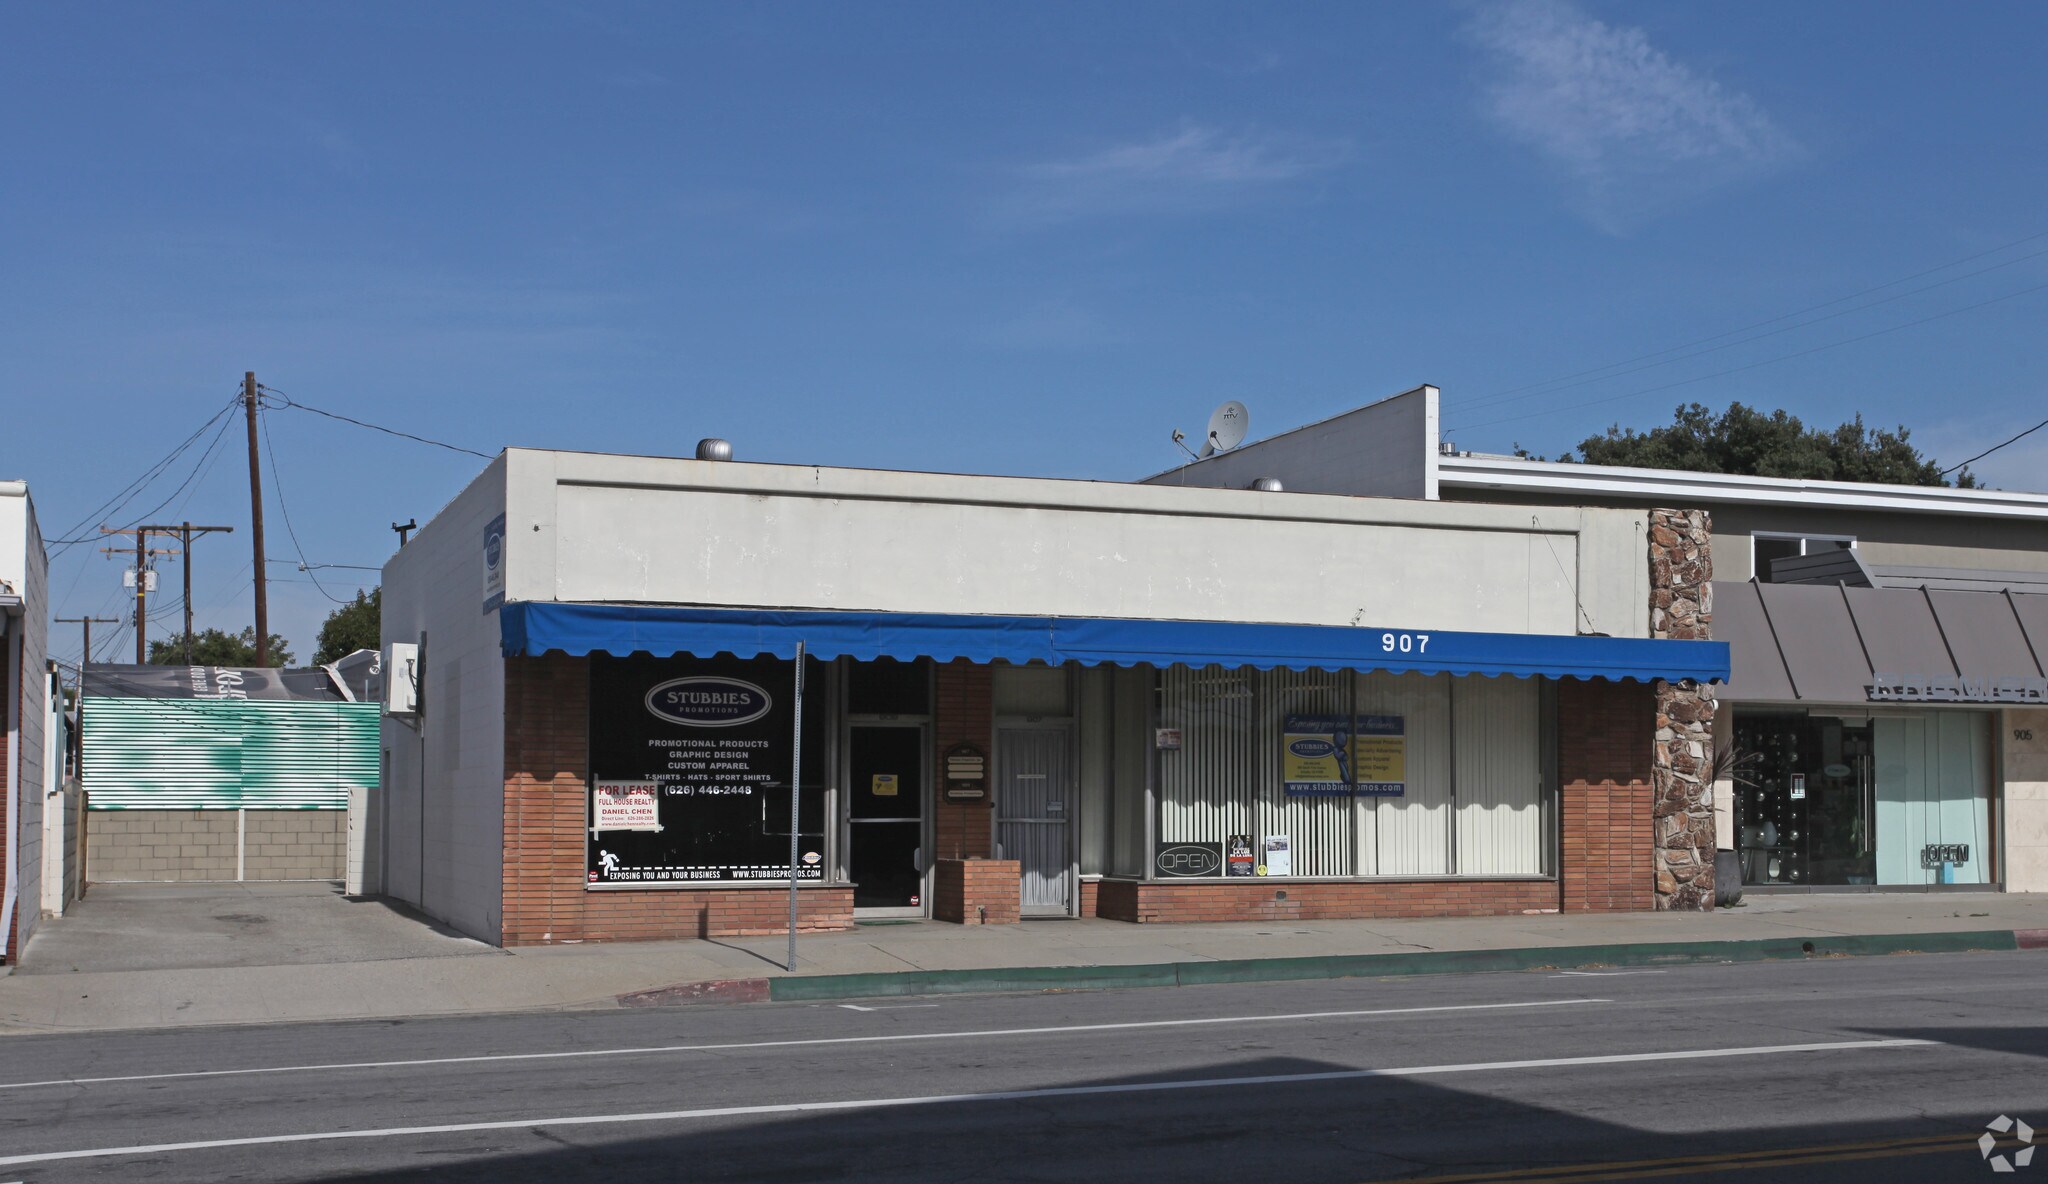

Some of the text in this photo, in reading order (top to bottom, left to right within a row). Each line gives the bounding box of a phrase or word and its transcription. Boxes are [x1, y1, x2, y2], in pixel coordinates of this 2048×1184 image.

[1382, 633, 1429, 653] 907
[667, 692, 750, 704] STUBBIES
[2014, 730, 2032, 740] 905
[599, 786, 655, 795] FOR LEASE
[665, 786, 751, 796] (626) 446-2448
[1926, 844, 1969, 862] OPEN
[1162, 853, 1216, 868] OPEN
[610, 871, 640, 880] EXPOSING
[643, 871, 654, 879] YOU
[691, 871, 720, 879] BUSINESS
